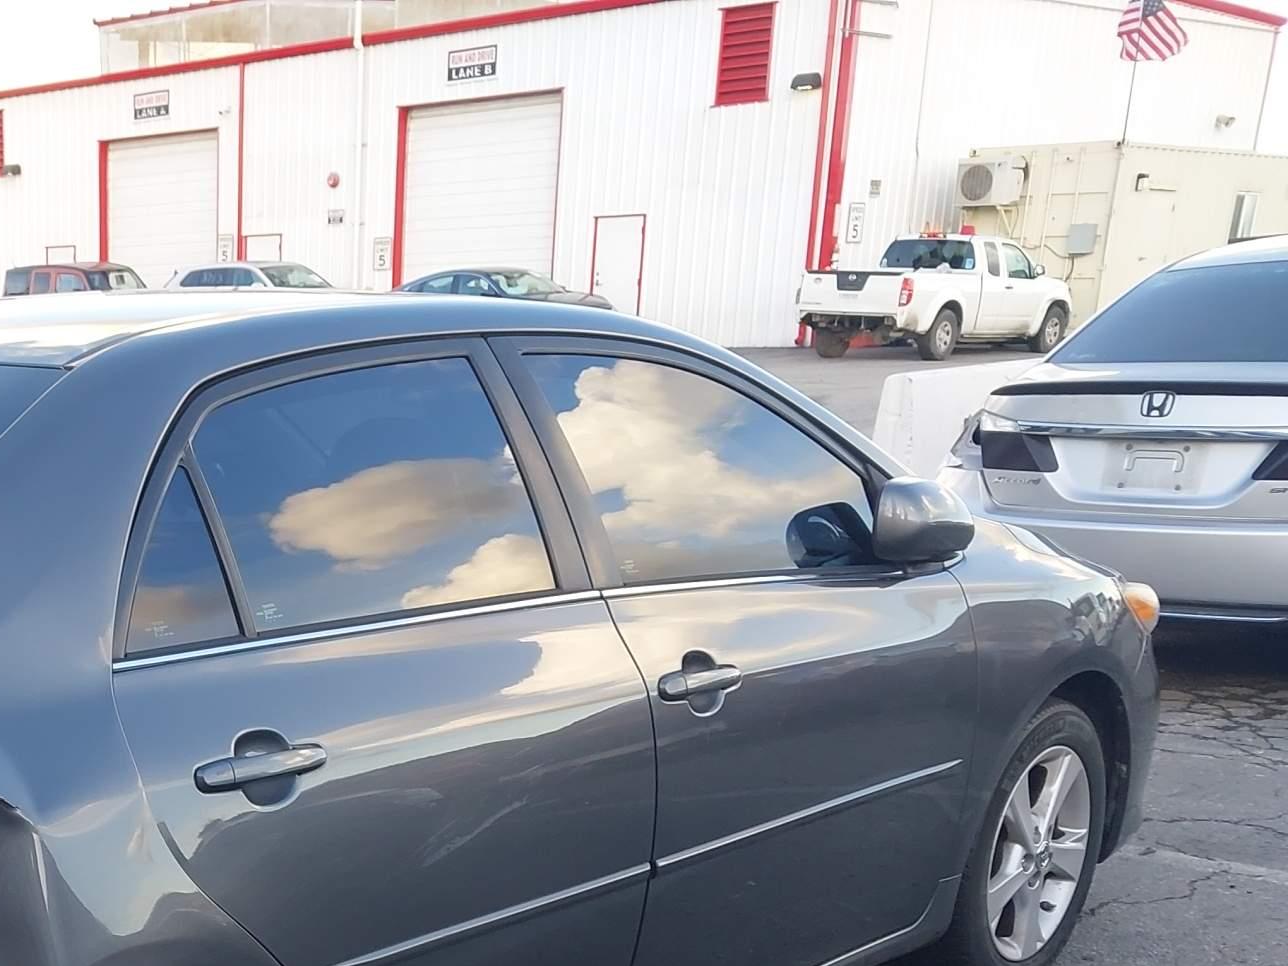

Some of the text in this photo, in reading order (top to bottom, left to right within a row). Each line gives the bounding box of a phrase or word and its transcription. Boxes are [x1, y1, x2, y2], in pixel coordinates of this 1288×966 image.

[464, 51, 476, 64] AND
[452, 64, 493, 79] LANE B
[137, 107, 156, 118] LANE
[851, 224, 859, 239] 5
[222, 249, 228, 262] 5
[378, 254, 386, 267] 5
